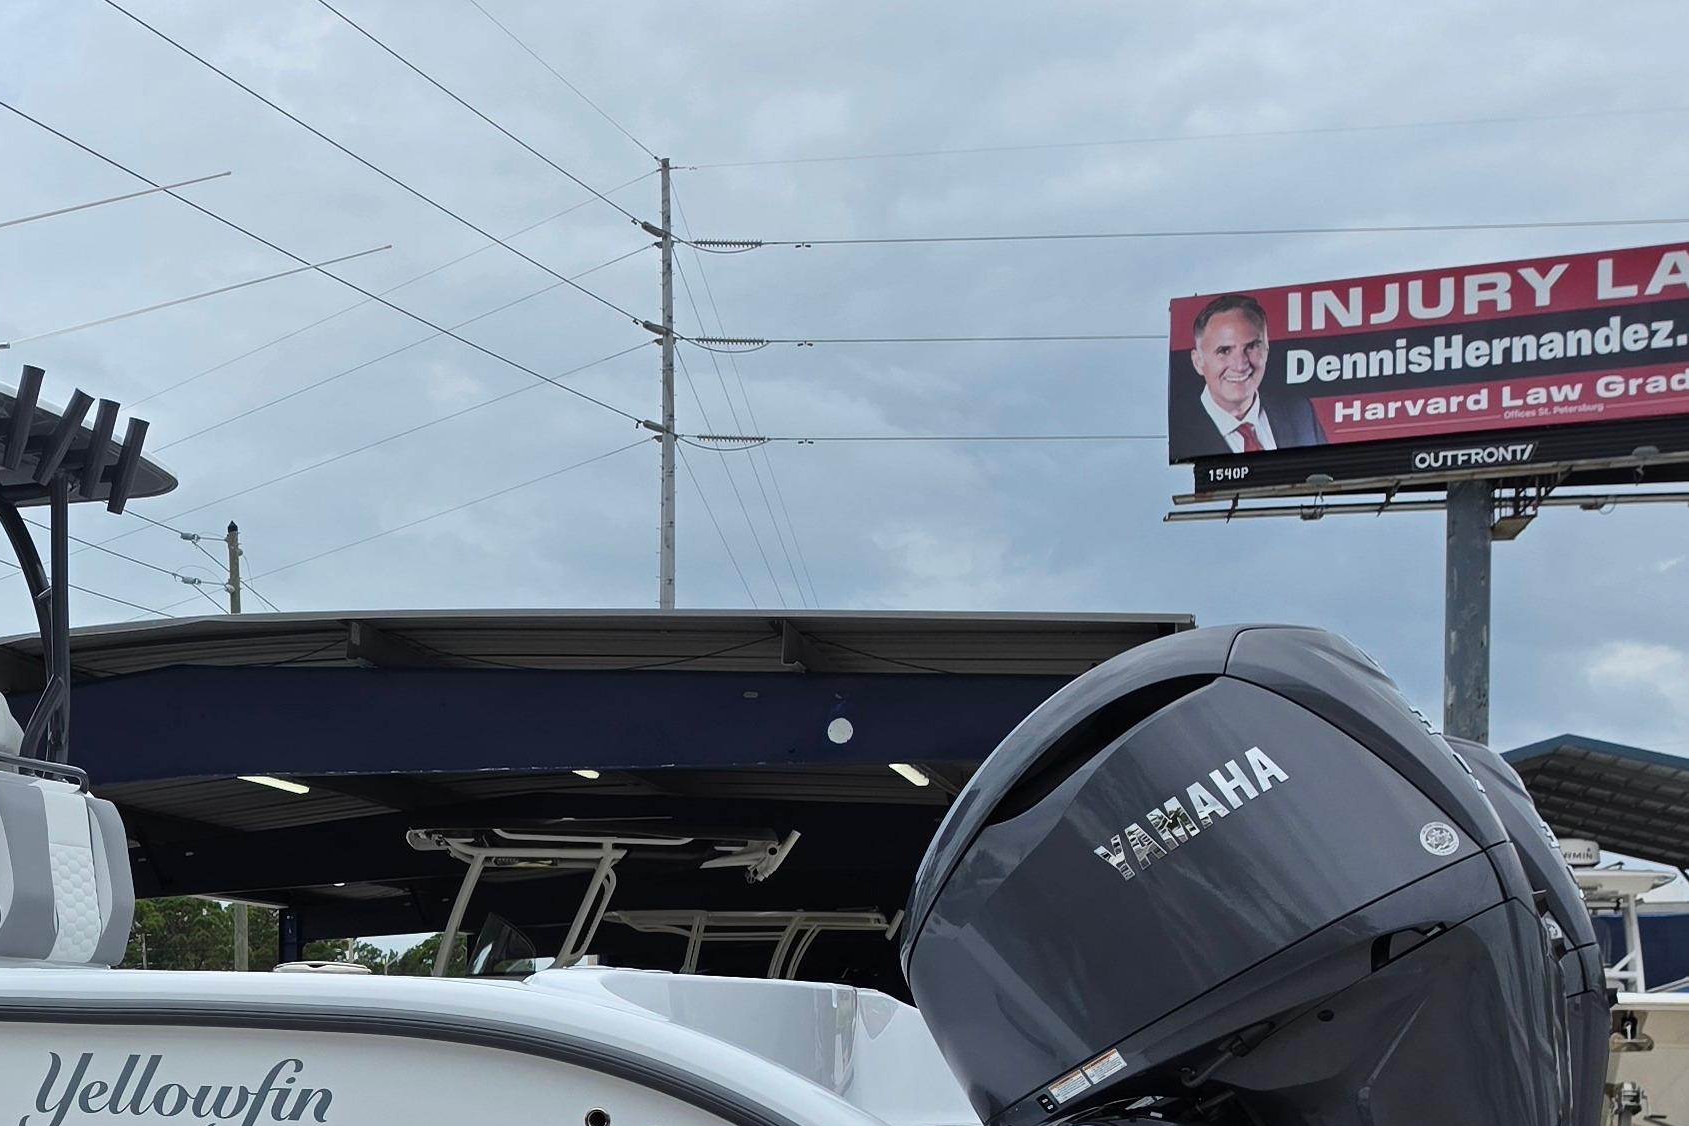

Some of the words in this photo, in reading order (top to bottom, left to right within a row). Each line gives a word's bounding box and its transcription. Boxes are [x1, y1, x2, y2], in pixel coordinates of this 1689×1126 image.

[1287, 263, 1568, 332] INJURY
[1597, 249, 1689, 300] LA
[1286, 316, 1688, 385] DennisHernandez.
[1334, 387, 1488, 423] Harvard
[1502, 383, 1582, 408] Law
[1596, 368, 1689, 398] Grad
[1503, 407, 1536, 420] Offices
[1537, 407, 1551, 417] St.
[1553, 402, 1604, 414] Petersburg
[1208, 466, 1250, 481] 1540P
[1094, 746, 1289, 881] YAMAHA
